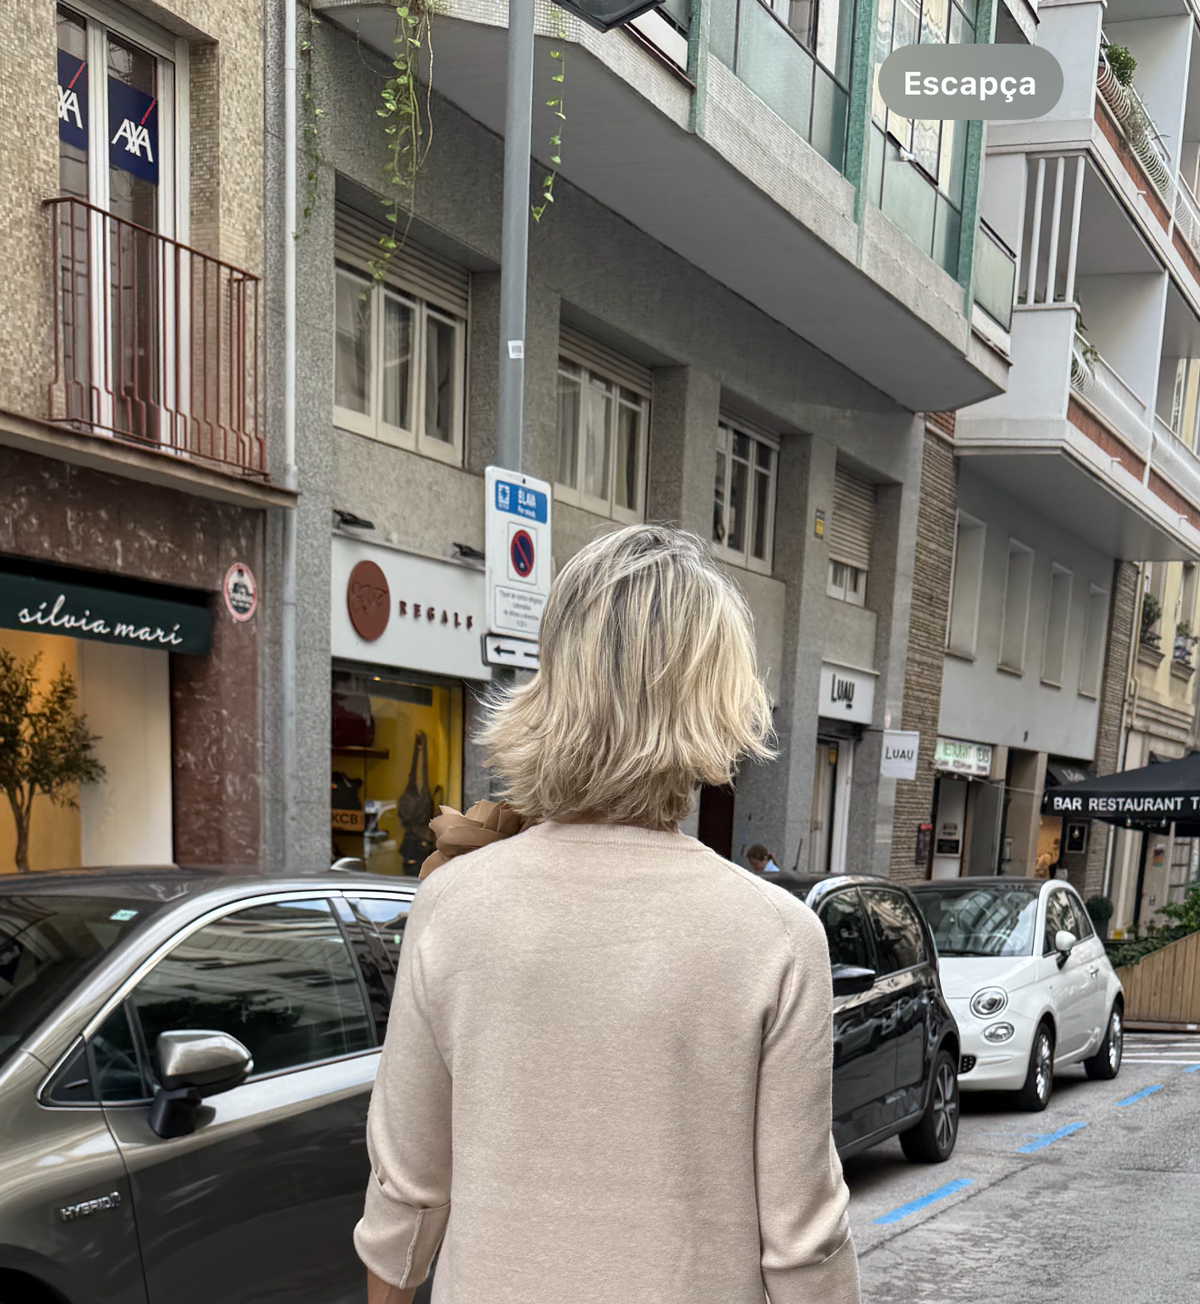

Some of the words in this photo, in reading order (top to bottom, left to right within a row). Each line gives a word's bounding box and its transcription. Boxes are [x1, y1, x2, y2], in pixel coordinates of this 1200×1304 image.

[57, 84, 83, 130] XA
[111, 118, 154, 163] AXA
[399, 600, 474, 630] REGALS
[1053, 796, 1082, 811] BAR
[1088, 796, 1184, 811] RESTAURANT
[1190, 796, 1200, 811] T
[60, 1191, 121, 1221] HYBRID
